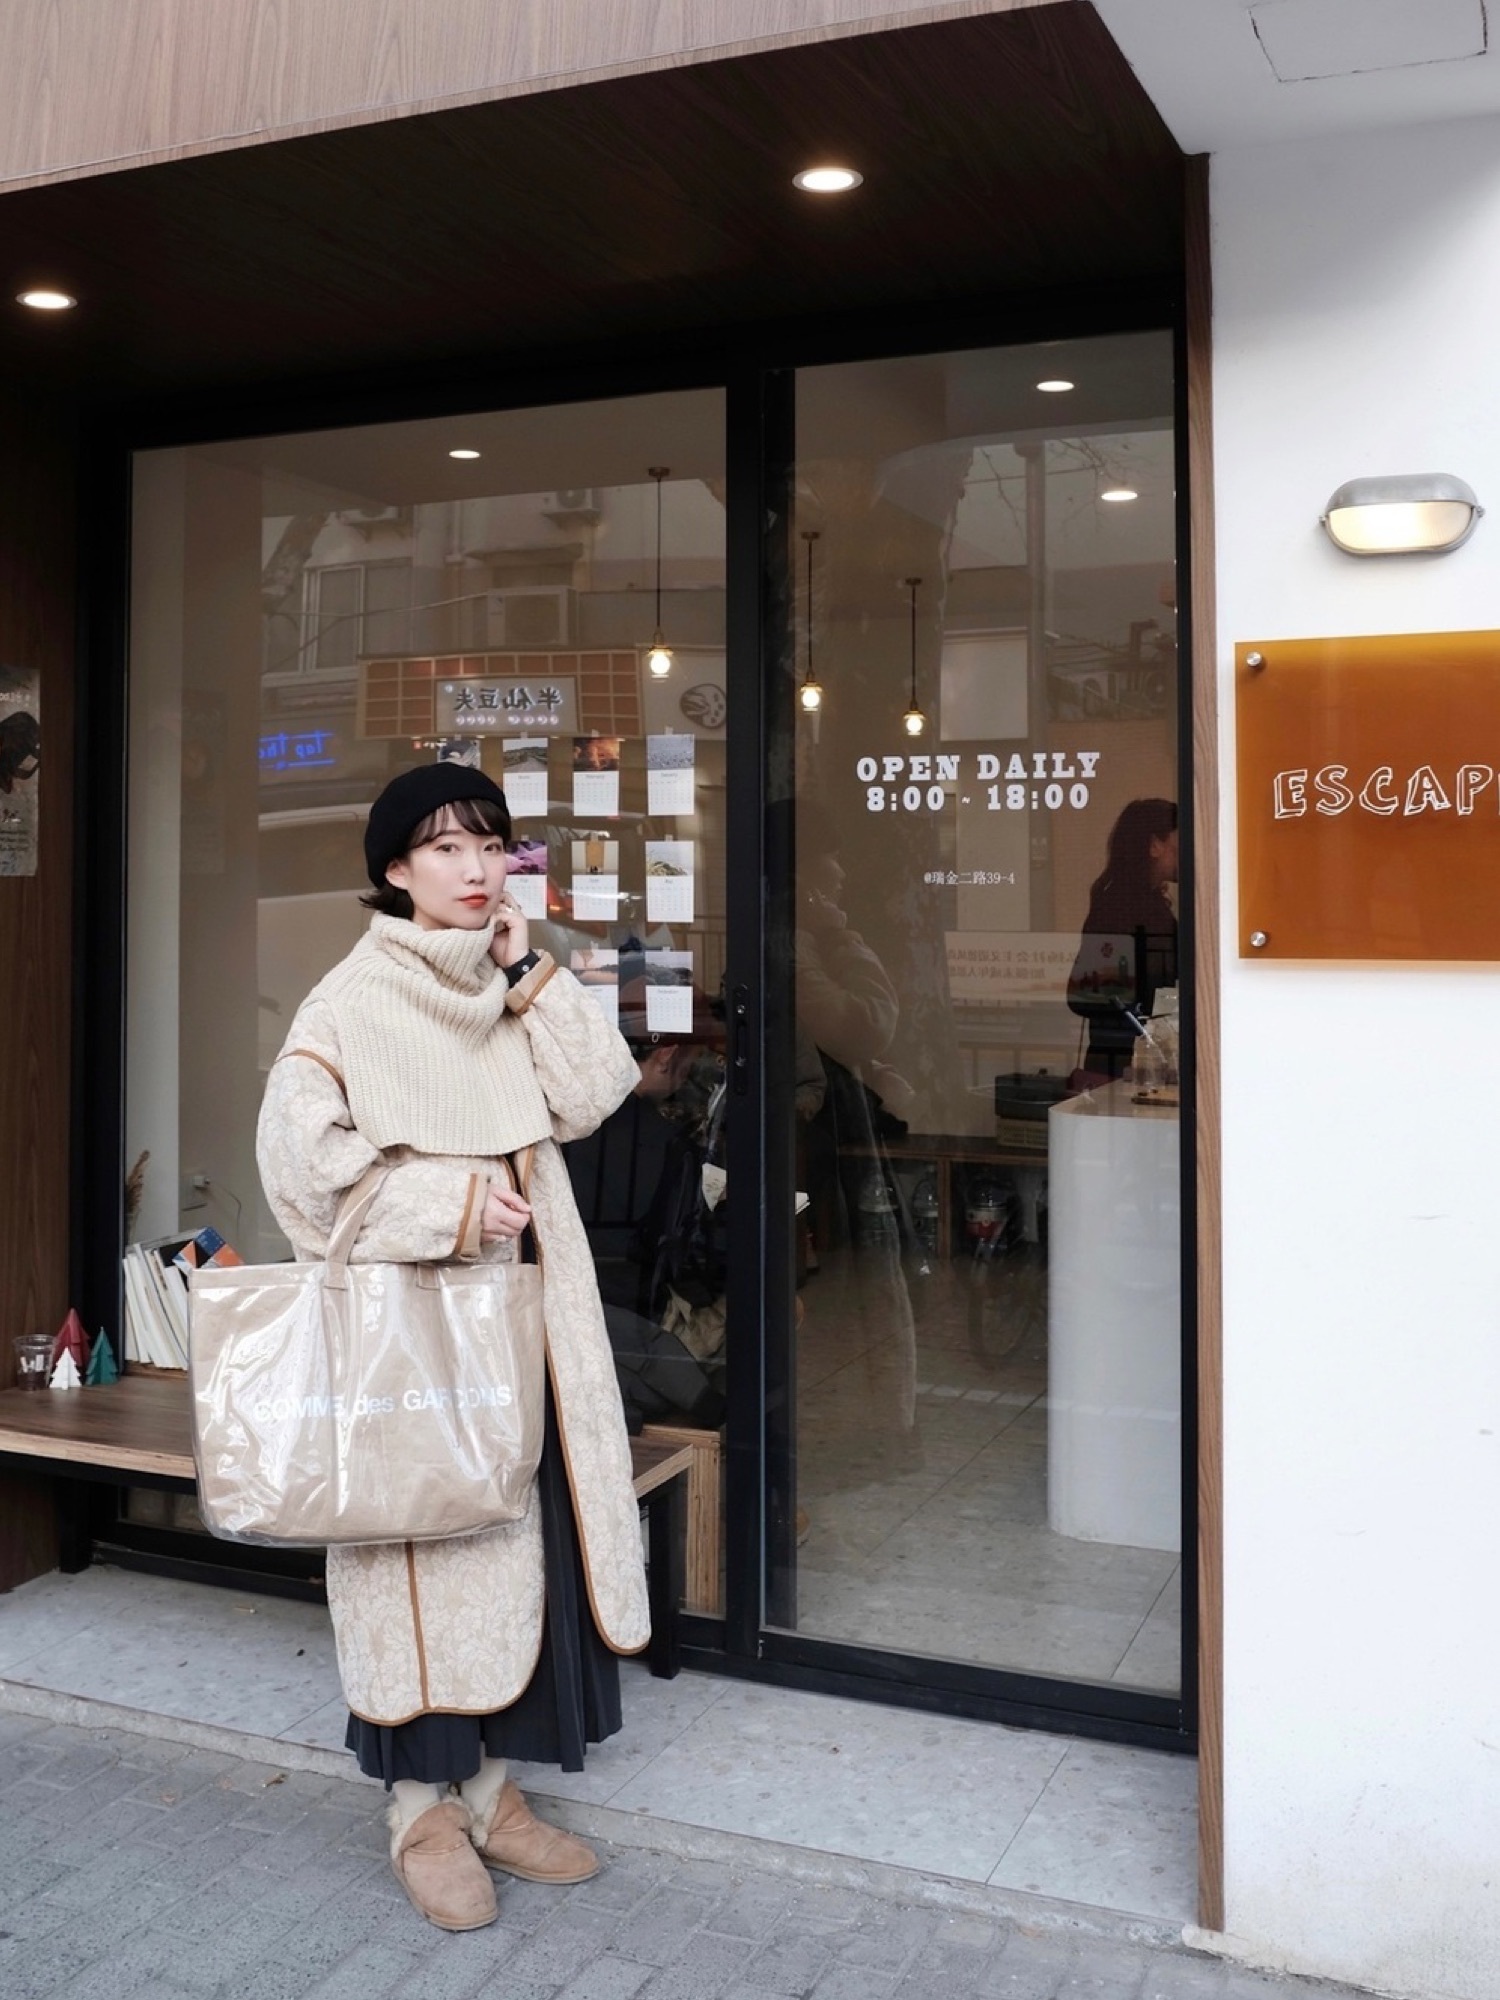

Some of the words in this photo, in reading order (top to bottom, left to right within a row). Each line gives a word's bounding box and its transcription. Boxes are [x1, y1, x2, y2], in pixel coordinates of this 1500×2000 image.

[856, 755, 961, 782] OPEN
[976, 752, 1100, 780] DAILY
[866, 785, 945, 811] 8:00
[987, 783, 1089, 810] 18:00
[1273, 764, 1500, 819] ESCAP
[253, 1395, 344, 1422] COMME
[353, 1393, 395, 1416] des
